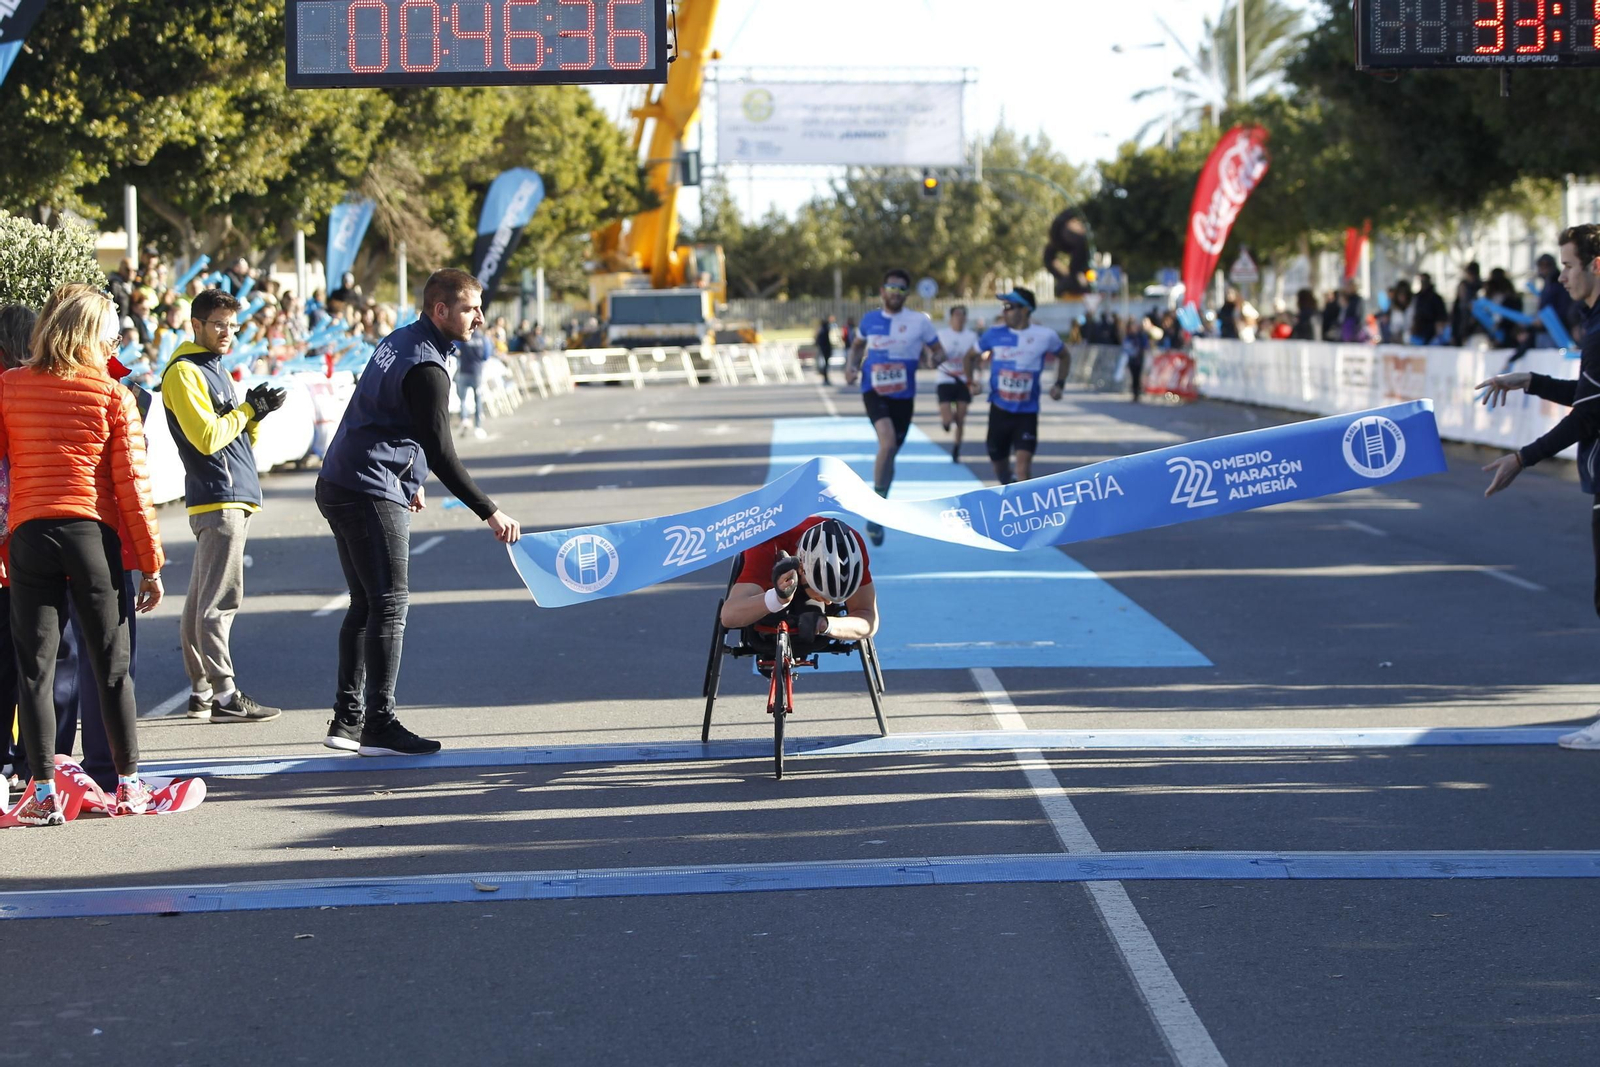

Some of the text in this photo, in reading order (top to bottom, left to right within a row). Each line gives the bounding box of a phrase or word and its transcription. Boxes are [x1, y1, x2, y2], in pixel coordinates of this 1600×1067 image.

[348, 0, 647, 72] 00:46:36
[1456, 55, 1515, 63] CRONOMETRAJE
[1222, 450, 1272, 470] MEDIO
[1225, 459, 1303, 485] MARATÓN
[998, 472, 1124, 522] ALMERÍA
[1229, 475, 1298, 501] ALMERÍA
[715, 505, 760, 530] MEDIO
[715, 503, 783, 541] MARATÓN
[1001, 511, 1066, 537] CIUDAD
[716, 517, 776, 553] ALMERÍA
